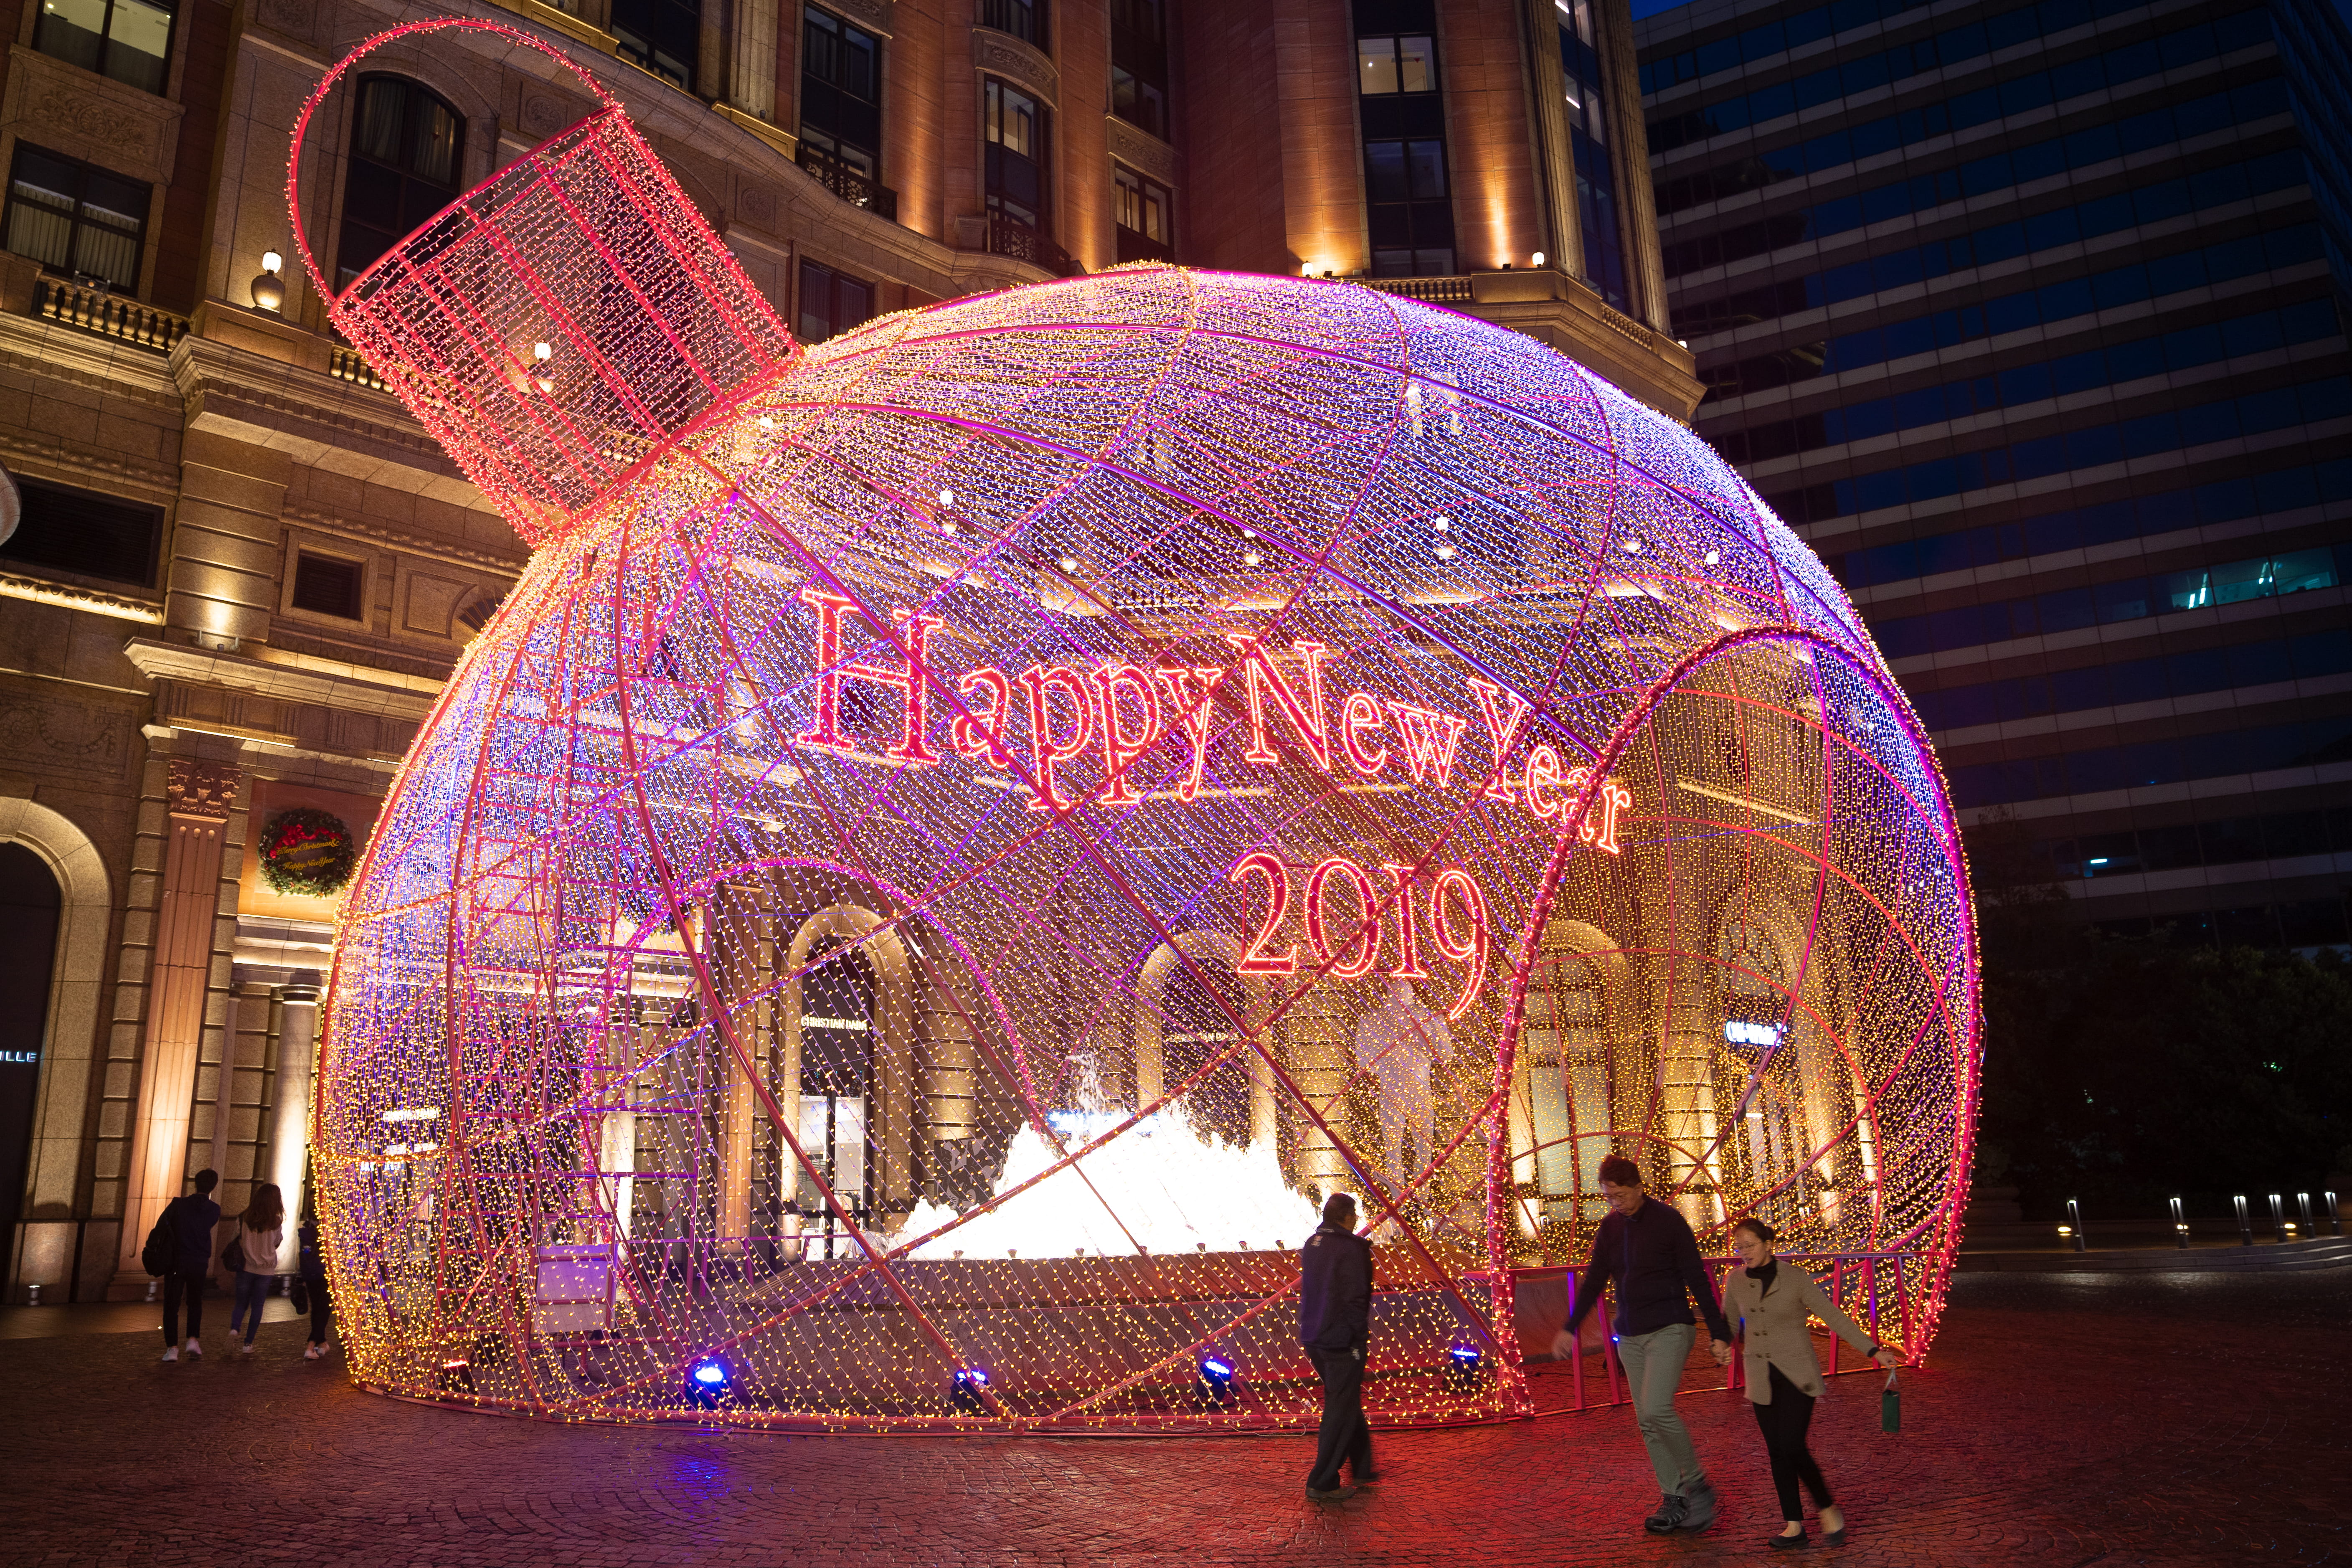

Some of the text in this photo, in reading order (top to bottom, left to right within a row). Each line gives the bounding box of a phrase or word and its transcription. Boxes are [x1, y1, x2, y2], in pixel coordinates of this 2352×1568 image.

[797, 589, 1631, 855] Happy New Year
[277, 846, 298, 855] Merry
[283, 862, 307, 872] Happy
[319, 856, 335, 867] Year
[1231, 852, 1488, 1020] 2019
[801, 1016, 845, 1030] CHRISTIAN
